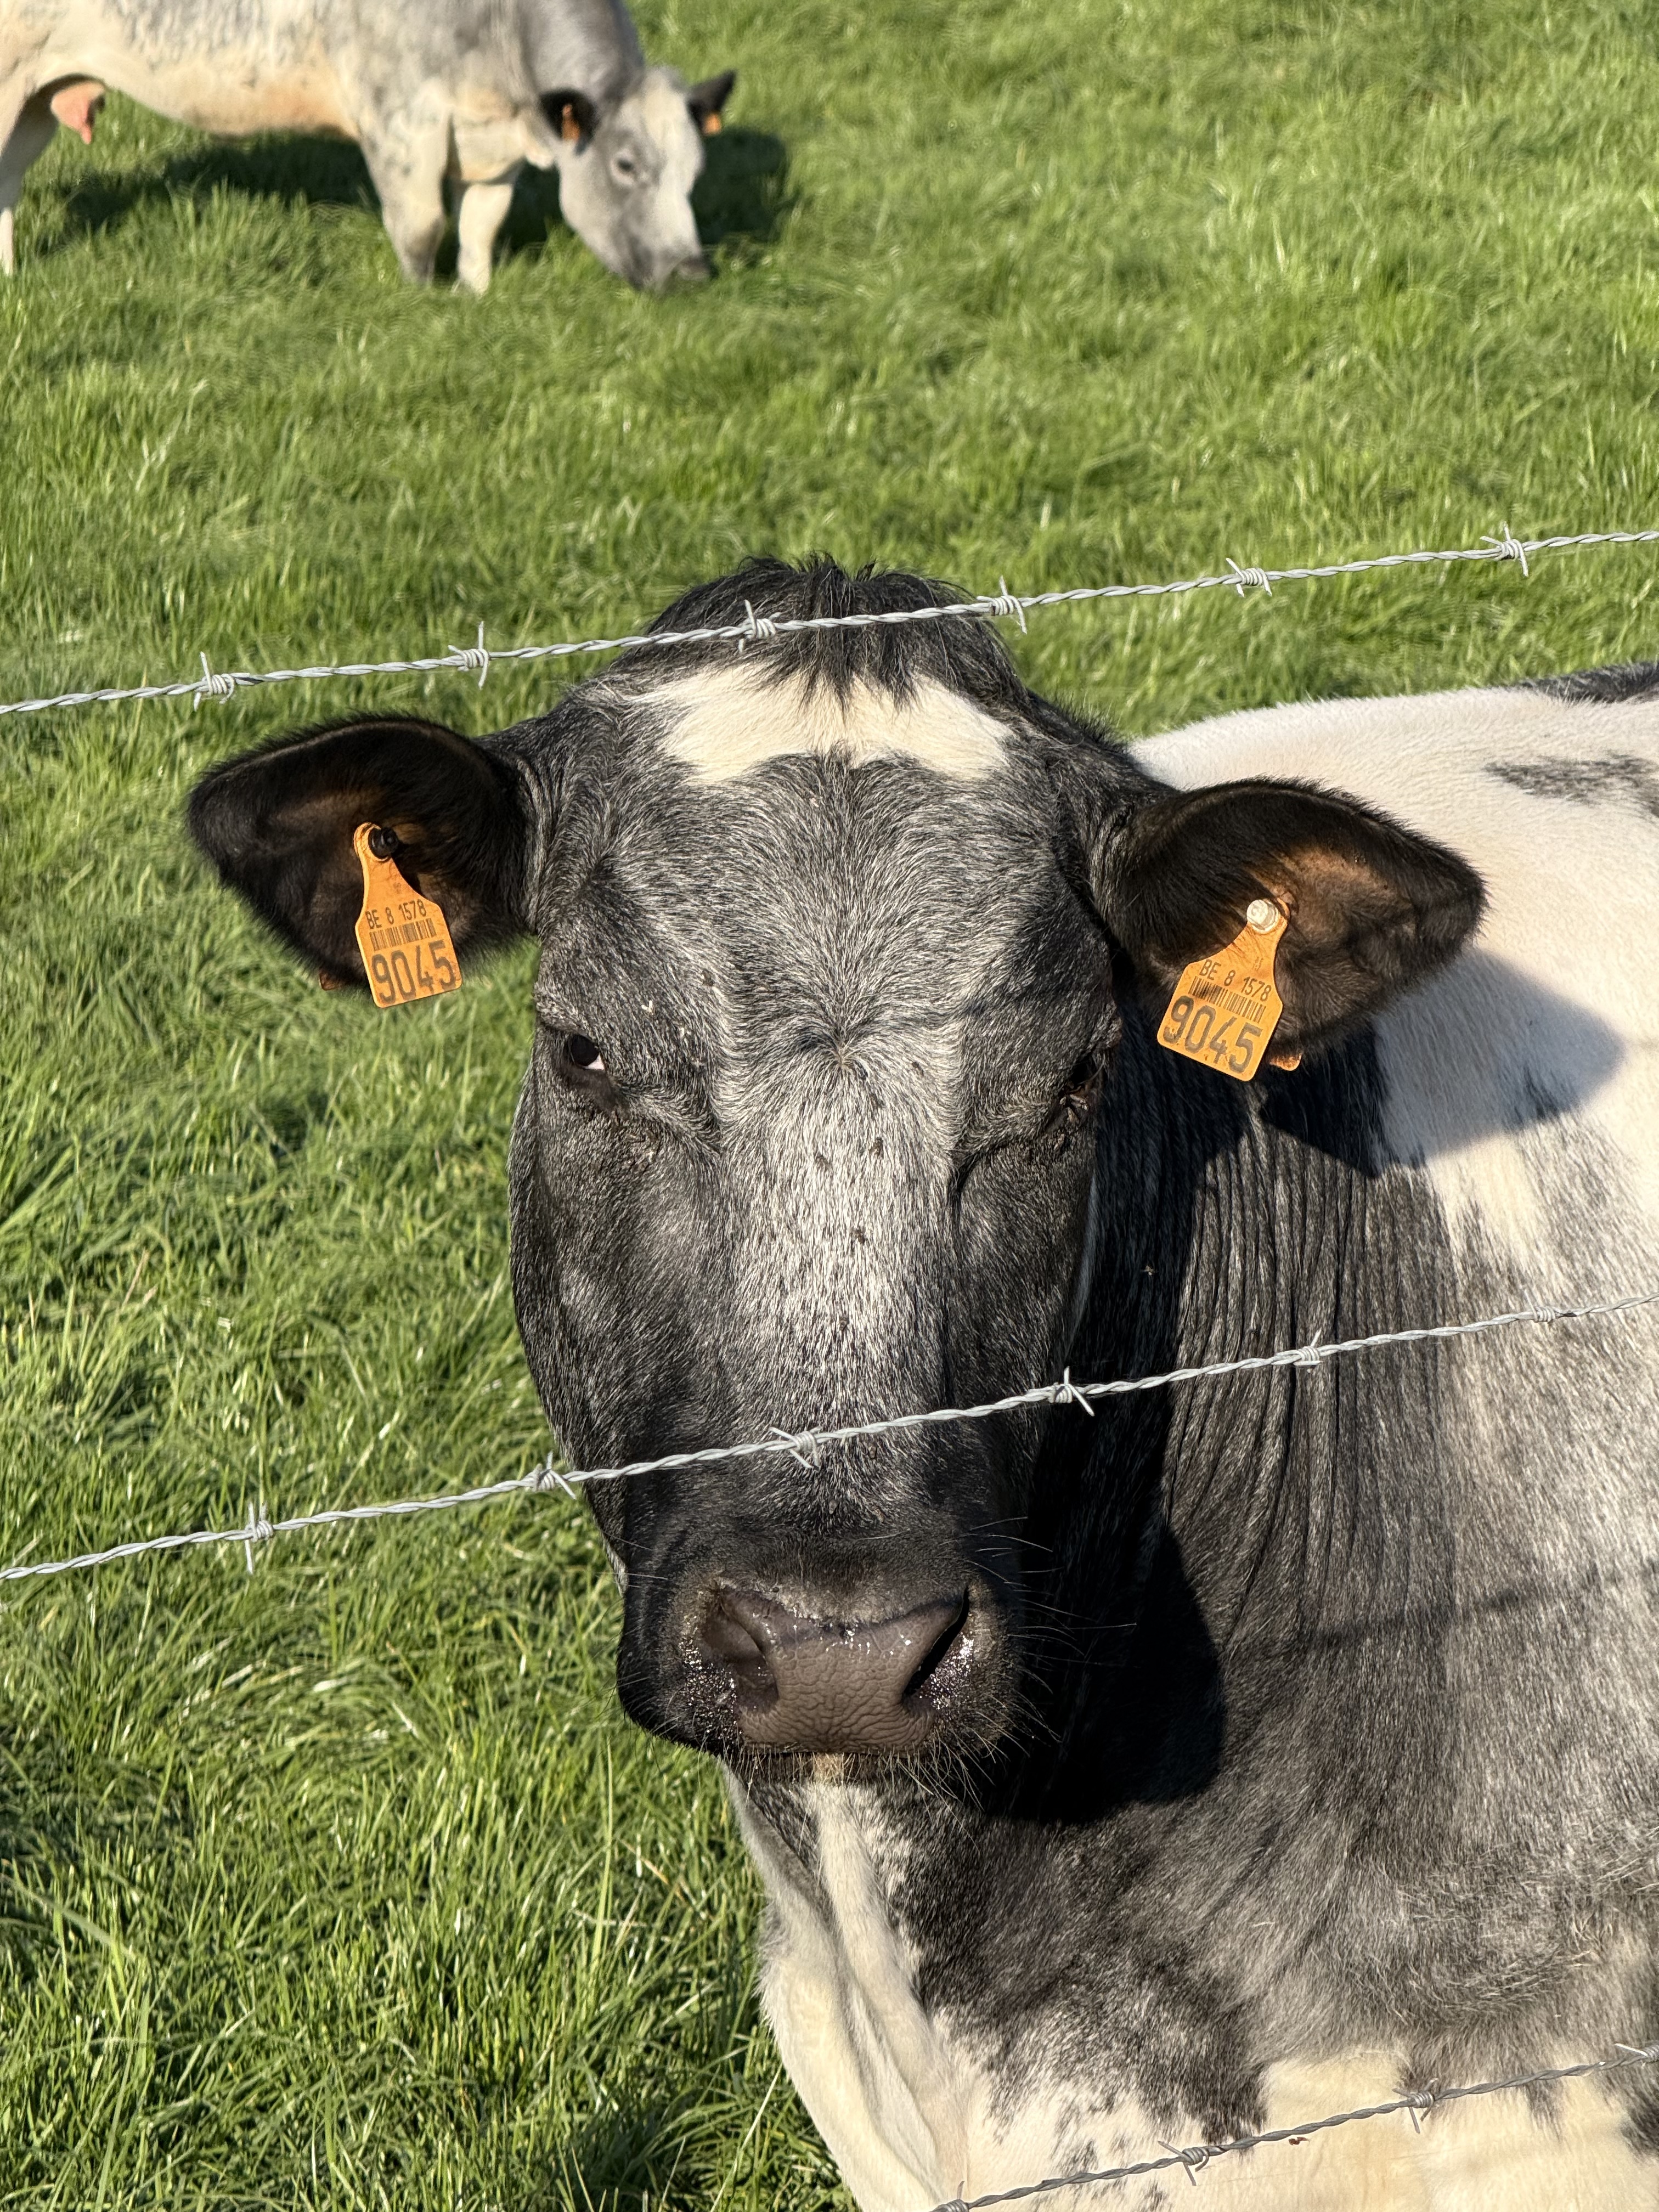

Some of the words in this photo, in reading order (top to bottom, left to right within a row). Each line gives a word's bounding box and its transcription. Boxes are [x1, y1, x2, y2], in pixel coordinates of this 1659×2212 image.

[365, 910, 381, 929] BE
[386, 907, 394, 924] 8
[399, 899, 427, 922] 1578
[371, 939, 456, 1005] 9045
[1200, 959, 1221, 981] BE
[1224, 969, 1235, 986] 8
[1242, 976, 1272, 1002] 1578
[1163, 995, 1263, 1073] 9045
